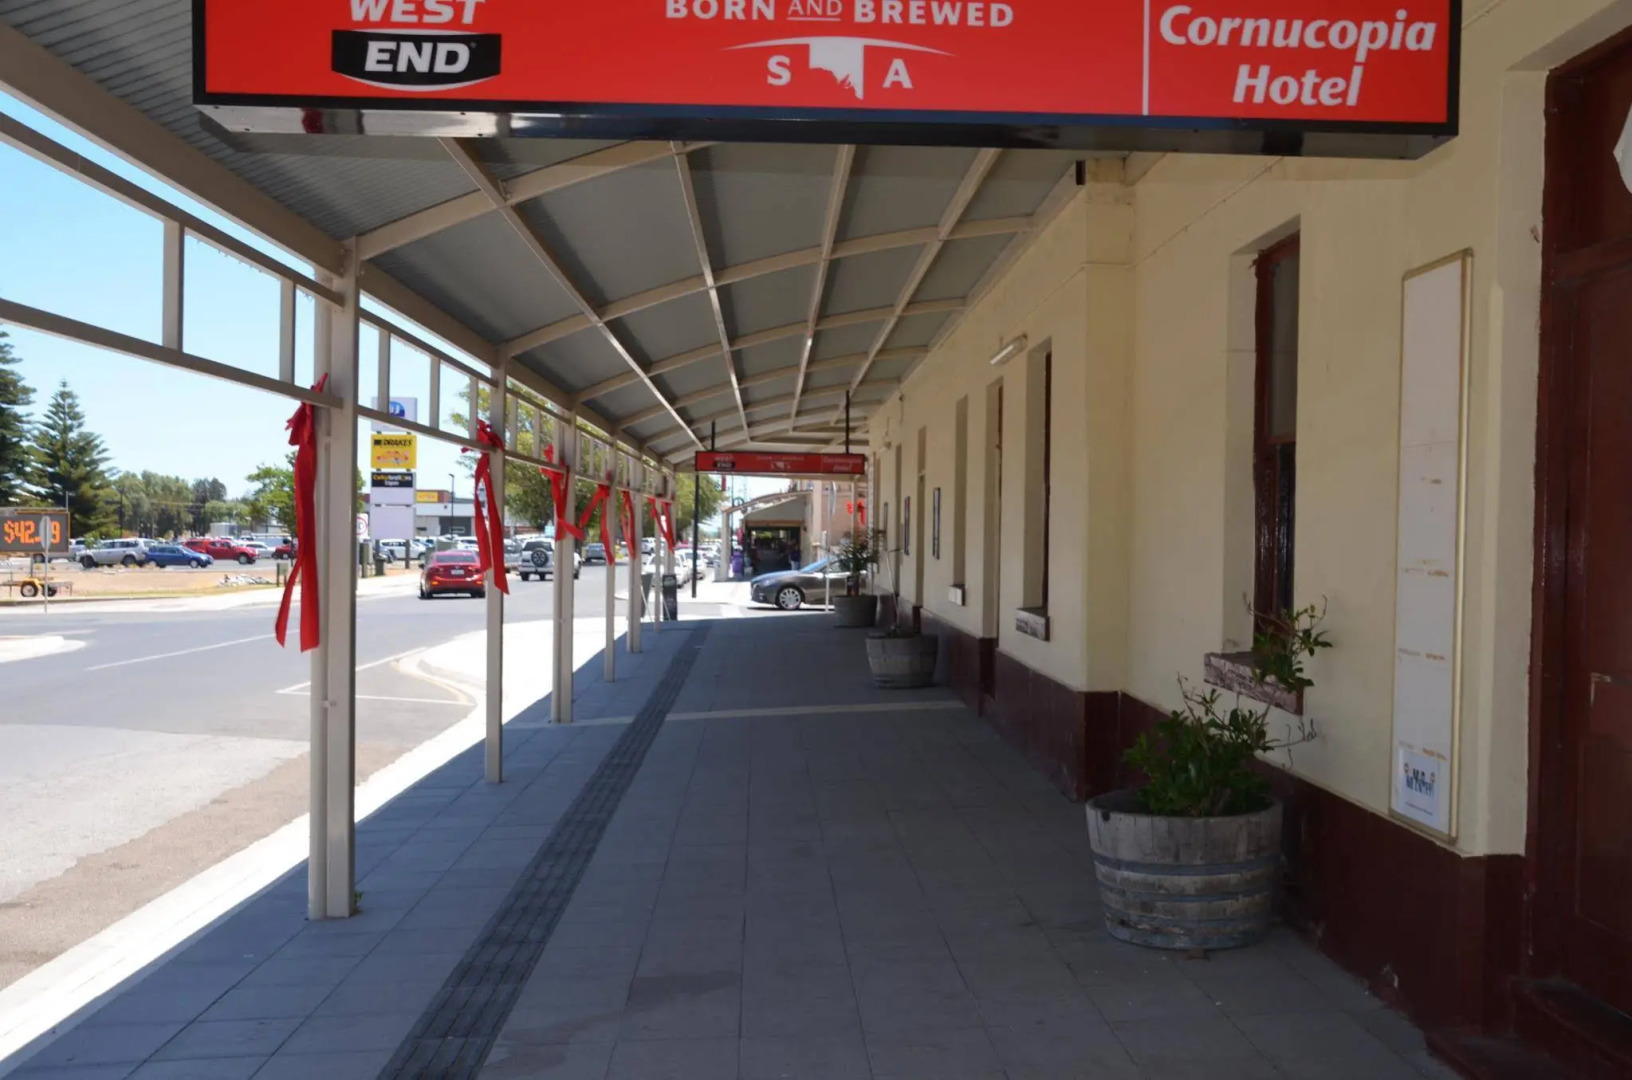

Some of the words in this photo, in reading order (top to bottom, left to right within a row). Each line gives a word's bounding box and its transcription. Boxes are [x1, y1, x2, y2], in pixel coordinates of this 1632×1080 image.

[350, 0, 486, 25] WEST
[665, 0, 776, 20] BORN
[787, 0, 844, 16] AND
[853, 0, 1015, 27] BREWED
[1159, 5, 1437, 62] Cornucopia
[364, 40, 471, 74] END
[767, 55, 792, 86] S
[882, 58, 914, 89] A
[1232, 63, 1364, 106] Hotel
